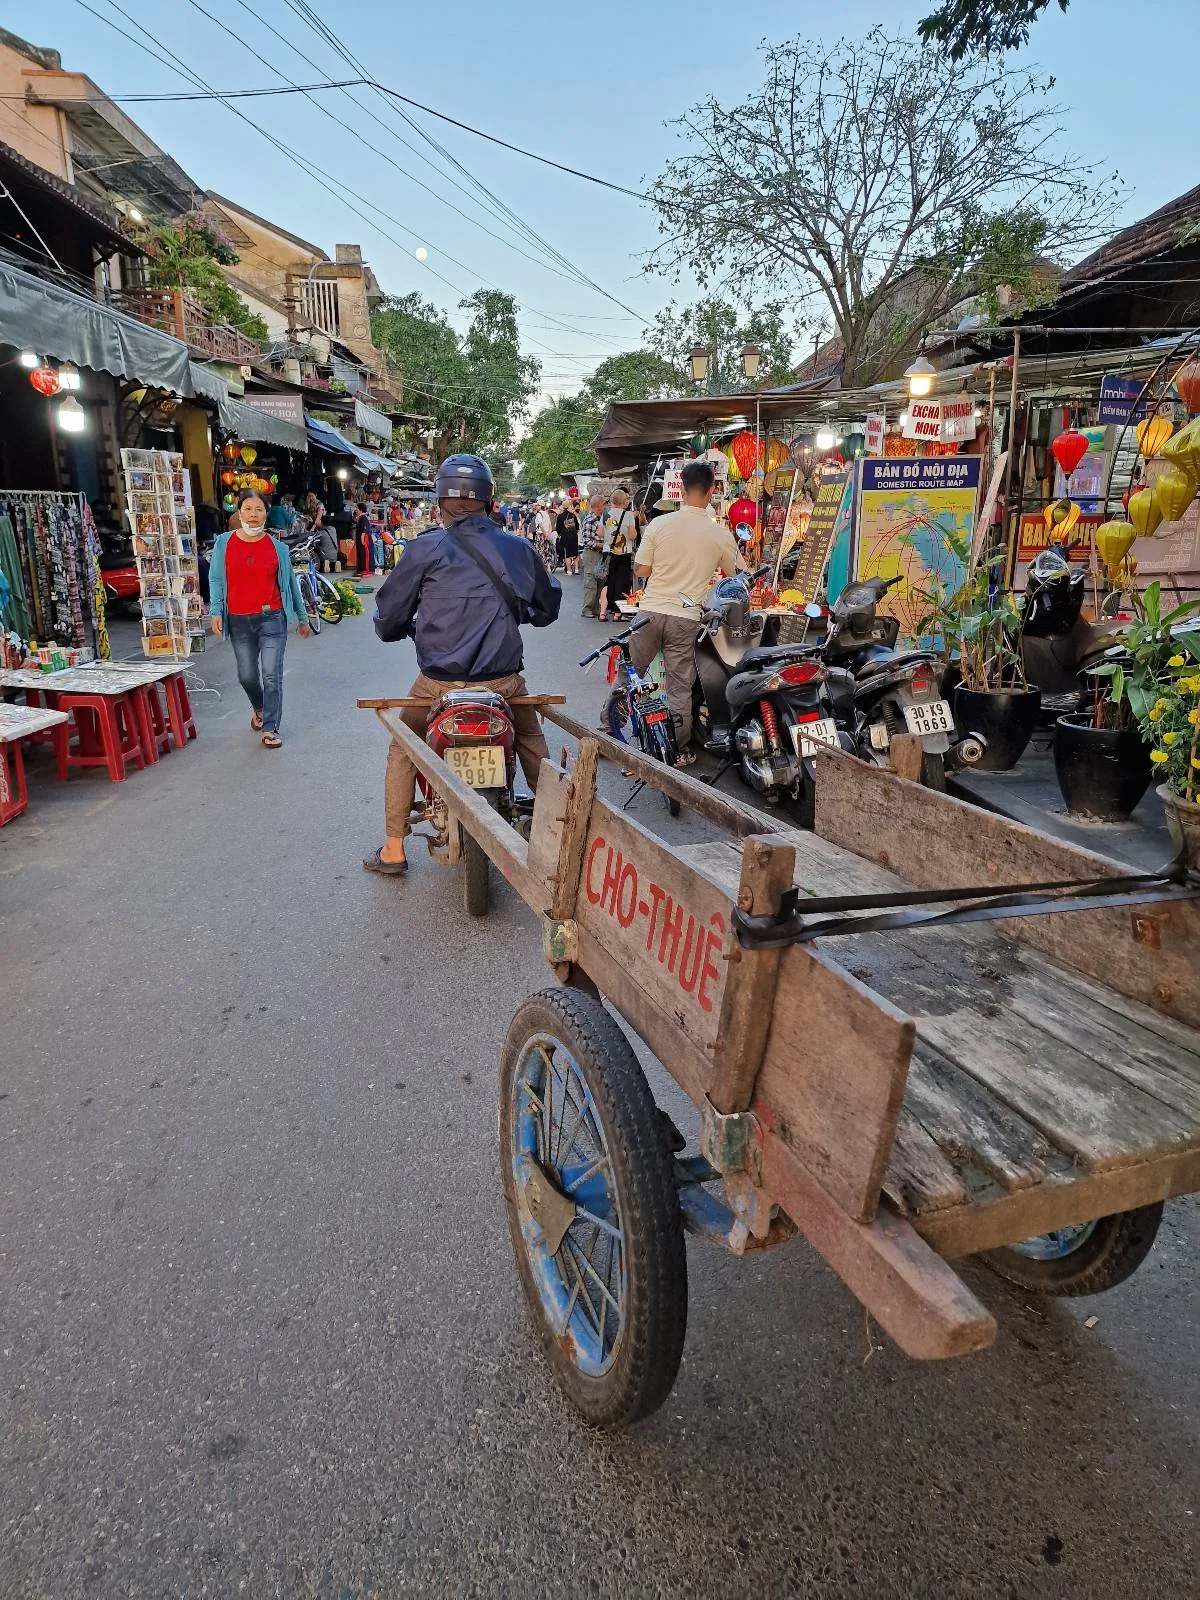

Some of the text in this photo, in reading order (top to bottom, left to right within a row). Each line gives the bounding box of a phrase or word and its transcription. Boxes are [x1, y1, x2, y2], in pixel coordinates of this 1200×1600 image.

[279, 409, 297, 418] HOA
[874, 461, 969, 479] BẢN ĐỒ NỘI ĐỊA
[877, 480, 917, 489] DOMESTIC
[919, 480, 944, 488] ROUTE
[910, 703, 944, 720] 30-K9
[915, 716, 948, 732] 1869
[453, 749, 496, 768] 92-F4
[586, 836, 726, 1013] CHO-THUÊ
